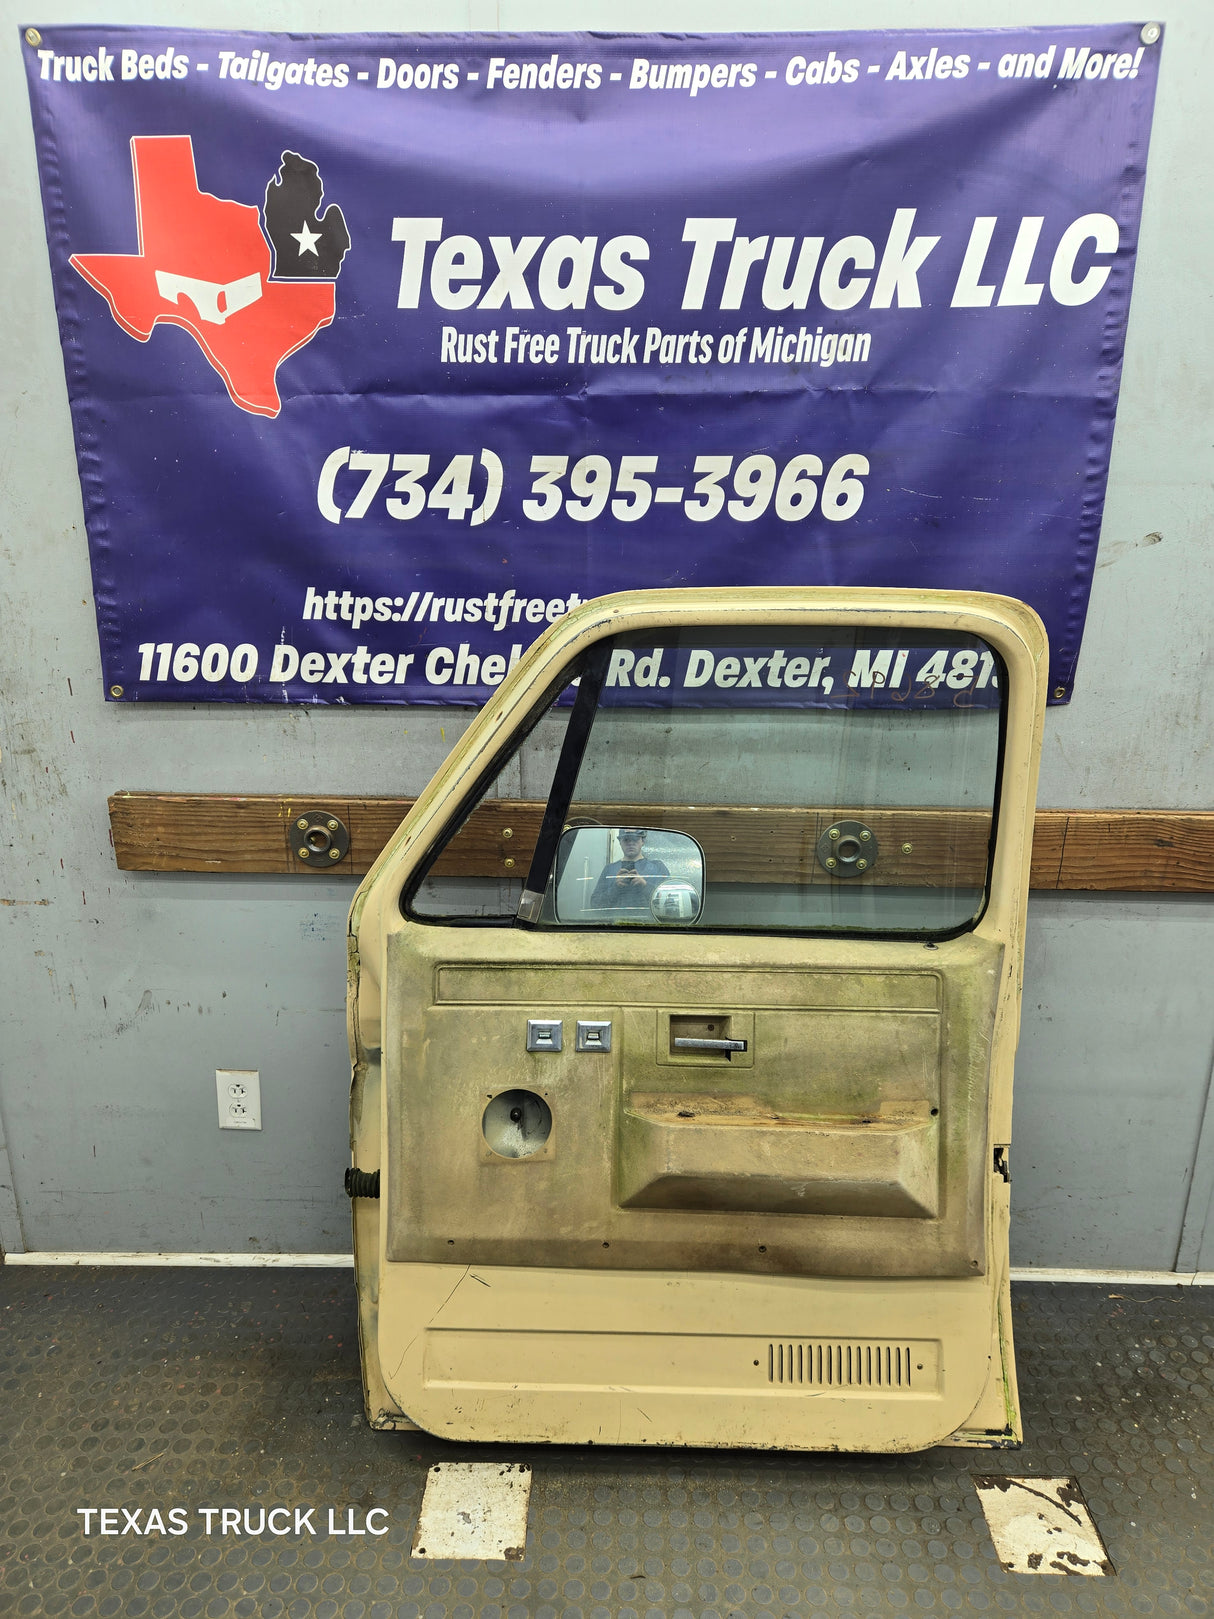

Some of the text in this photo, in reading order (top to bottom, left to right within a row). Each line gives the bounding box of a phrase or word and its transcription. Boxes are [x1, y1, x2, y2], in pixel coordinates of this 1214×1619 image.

[37, 47, 115, 82] Truck
[121, 47, 190, 82] Beds
[216, 51, 350, 92] Tailgates
[376, 57, 460, 90] Doors
[486, 54, 603, 90] Fenders
[628, 57, 758, 98] Bumpers
[785, 51, 860, 86] Cabs
[885, 48, 972, 82] Axles
[997, 47, 1057, 80] and
[1057, 46, 1146, 81] More!
[391, 208, 1120, 311] Texas Truck LLC
[441, 326, 873, 369] Rust Free Truck Parts of Michigan
[316, 446, 871, 527] (734) 395-3966
[138, 642, 259, 683] 11600
[269, 644, 414, 685] Dexter
[605, 649, 671, 688] Rd.
[684, 649, 835, 695] Dexter,
[848, 649, 909, 689] MI
[916, 649, 999, 690] 481
